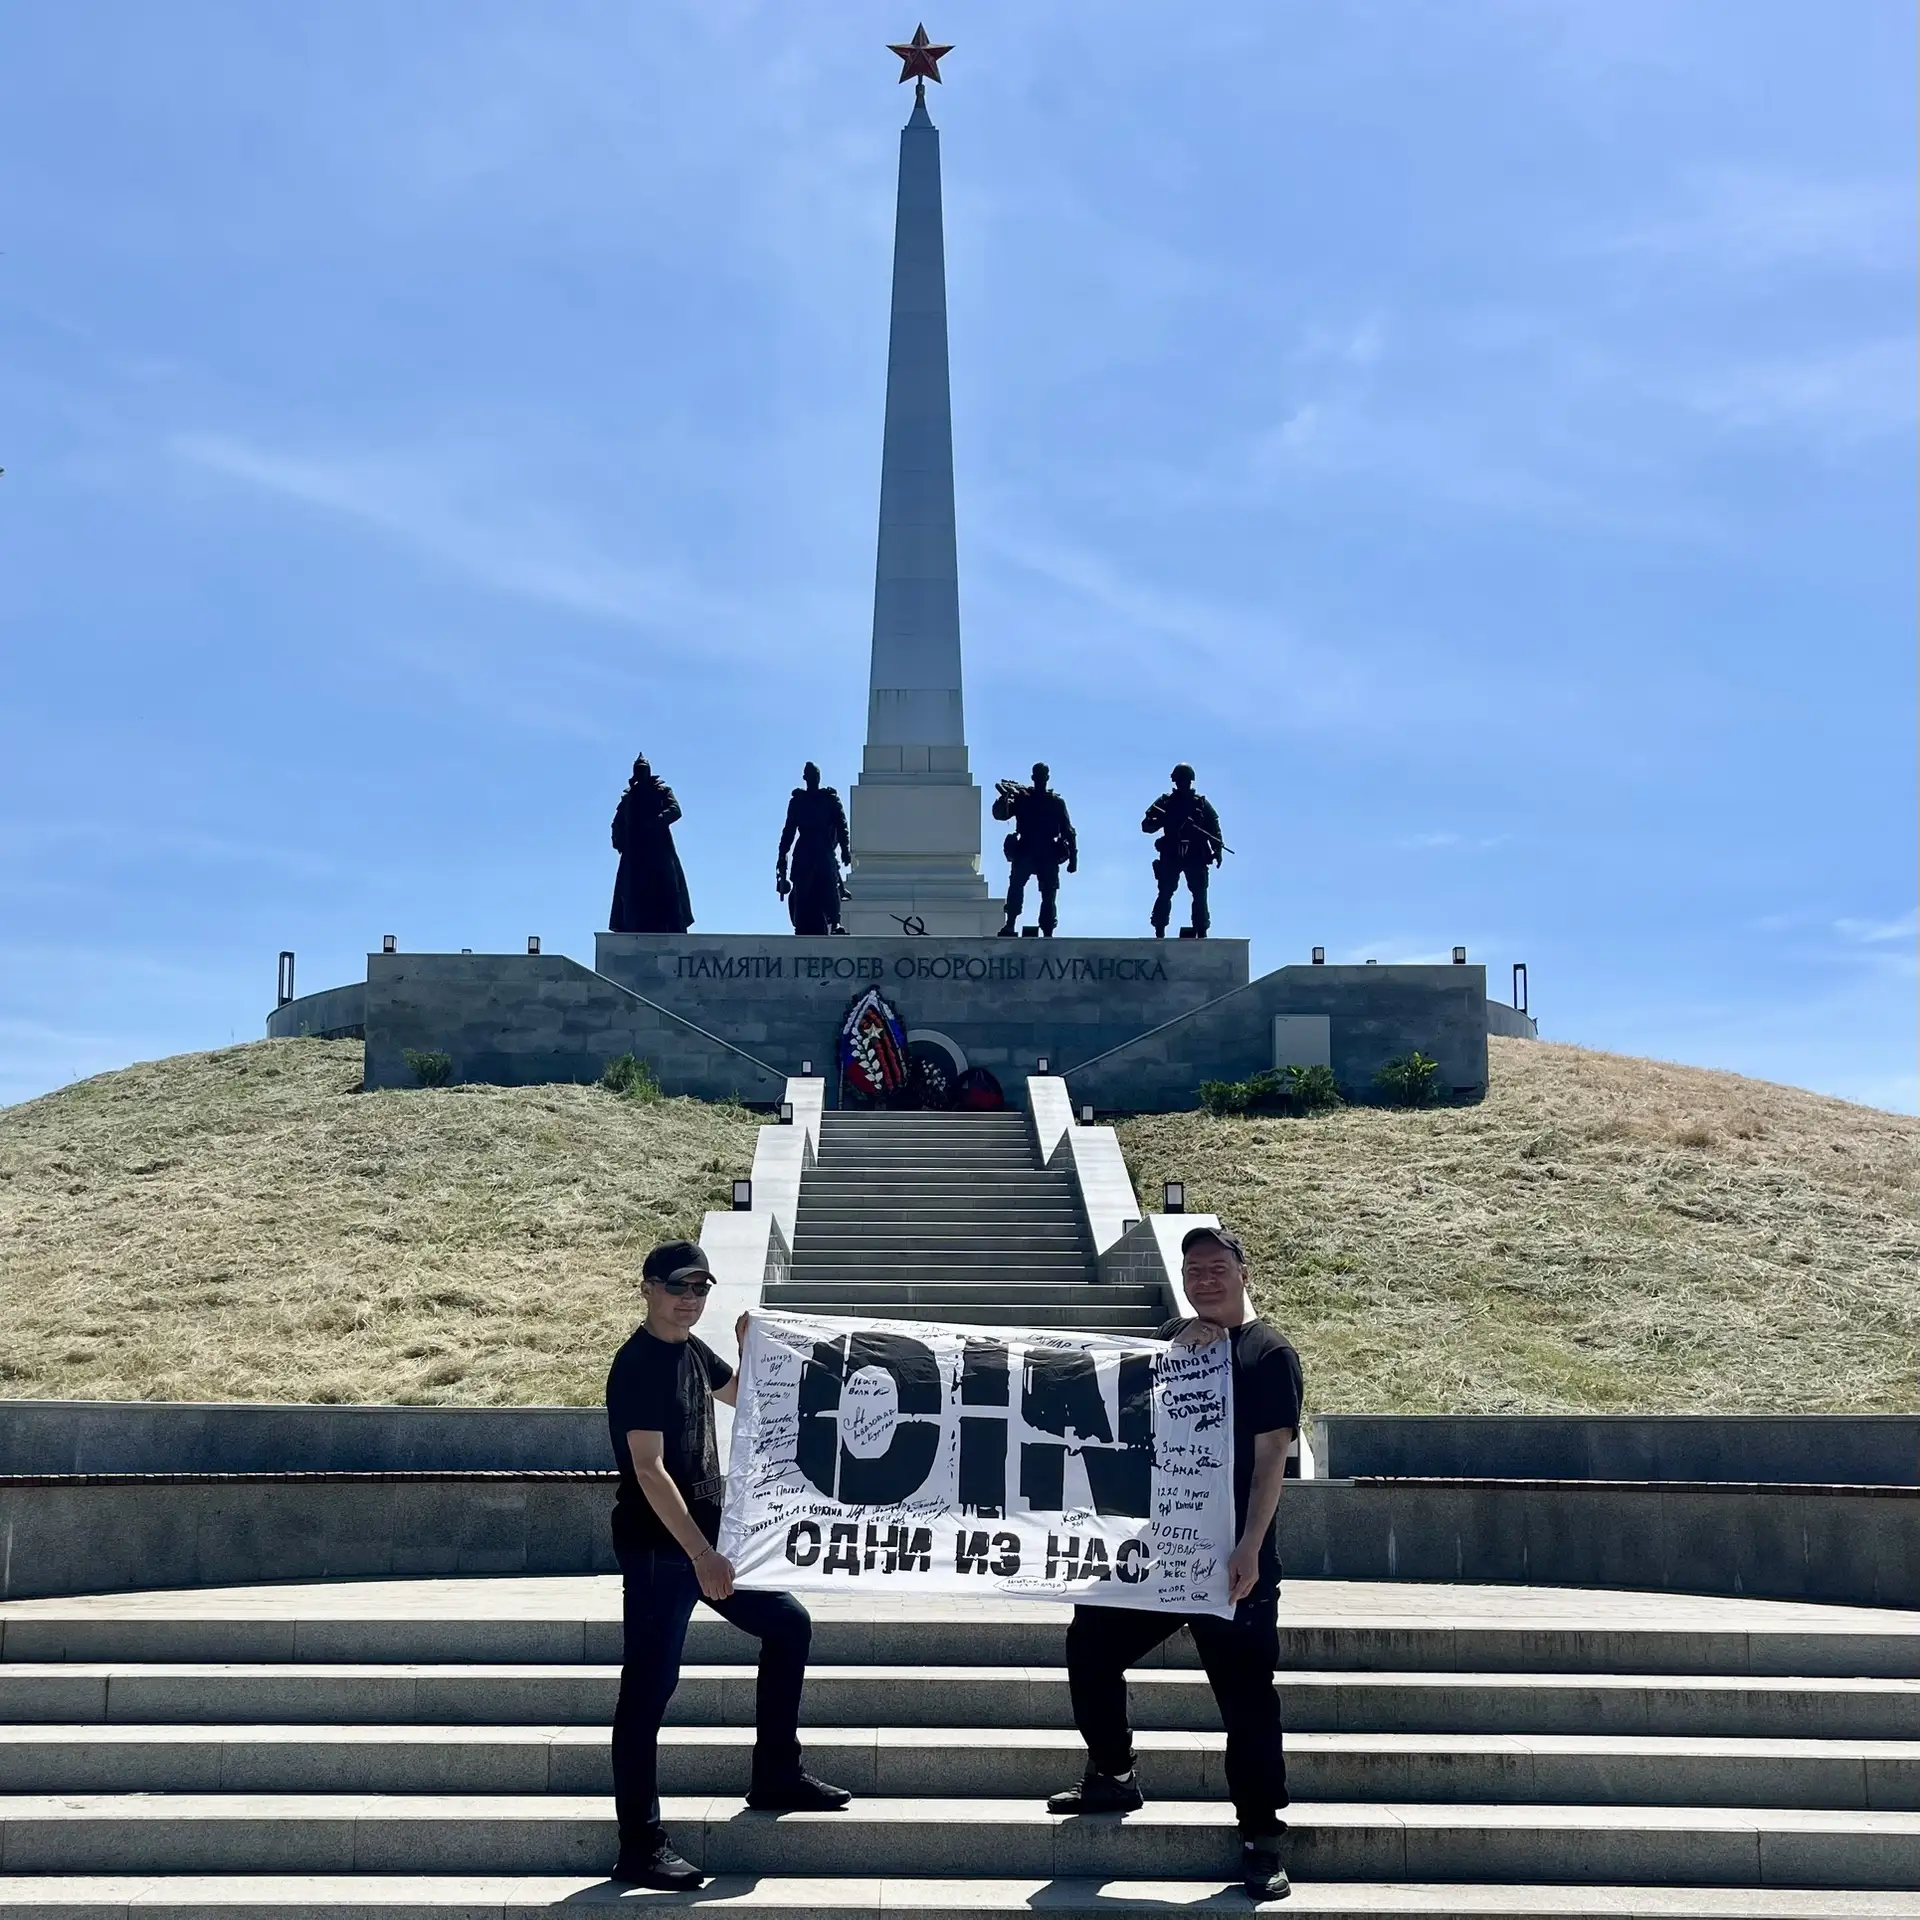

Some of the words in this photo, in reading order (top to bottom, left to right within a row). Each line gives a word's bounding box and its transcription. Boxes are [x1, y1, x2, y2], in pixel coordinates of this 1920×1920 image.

[675, 955, 784, 980] ПАМЯТИ
[793, 956, 885, 981] ГЕРОЕВ
[893, 957, 1026, 982] ОБОРОНЫ
[1036, 957, 1169, 982] ЛУГАНСКА
[785, 1521, 932, 1575] ОДНИ
[955, 1529, 1022, 1577] ИЗ
[1045, 1532, 1151, 1583] НАС
